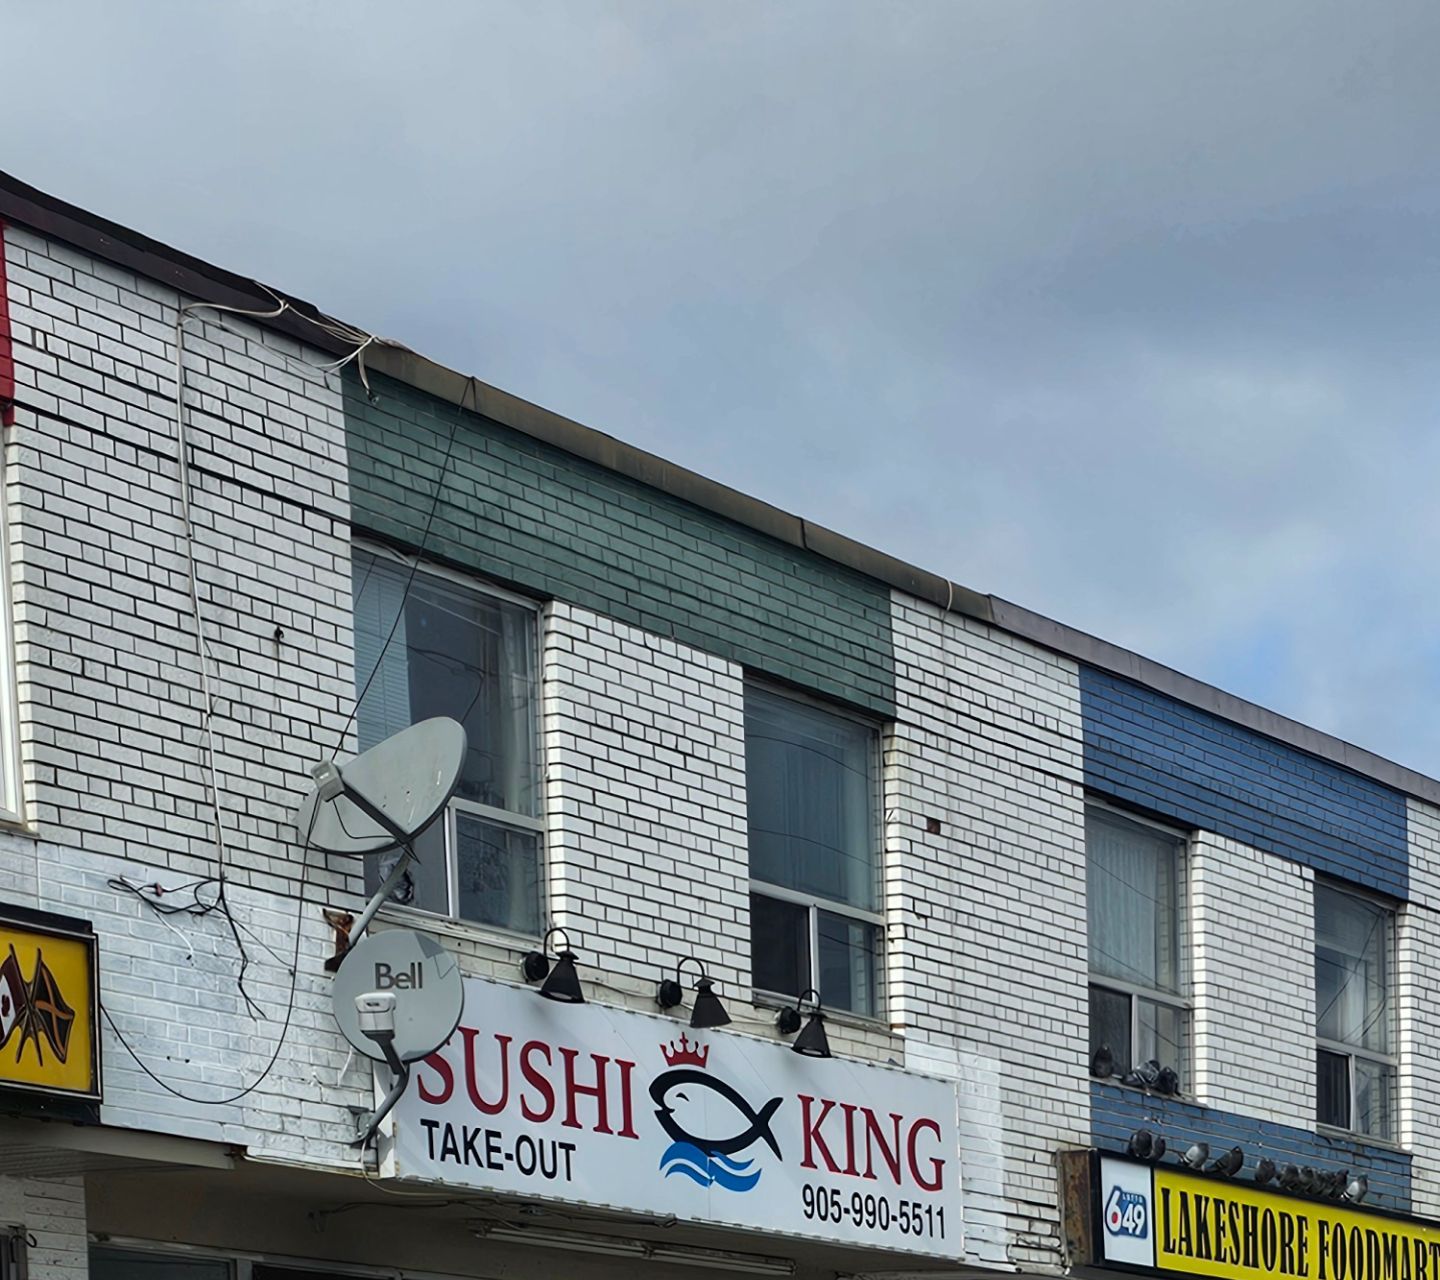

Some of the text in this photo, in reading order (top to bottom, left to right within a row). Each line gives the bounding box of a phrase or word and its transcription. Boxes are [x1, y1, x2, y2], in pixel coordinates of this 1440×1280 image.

[374, 961, 423, 990] Bell
[417, 1026, 946, 1192] SUSHI KING
[420, 1117, 577, 1182] TAKE-OUT
[802, 1183, 945, 1240] 905-990-5511
[1160, 1187, 1309, 1278] LAKESHORE
